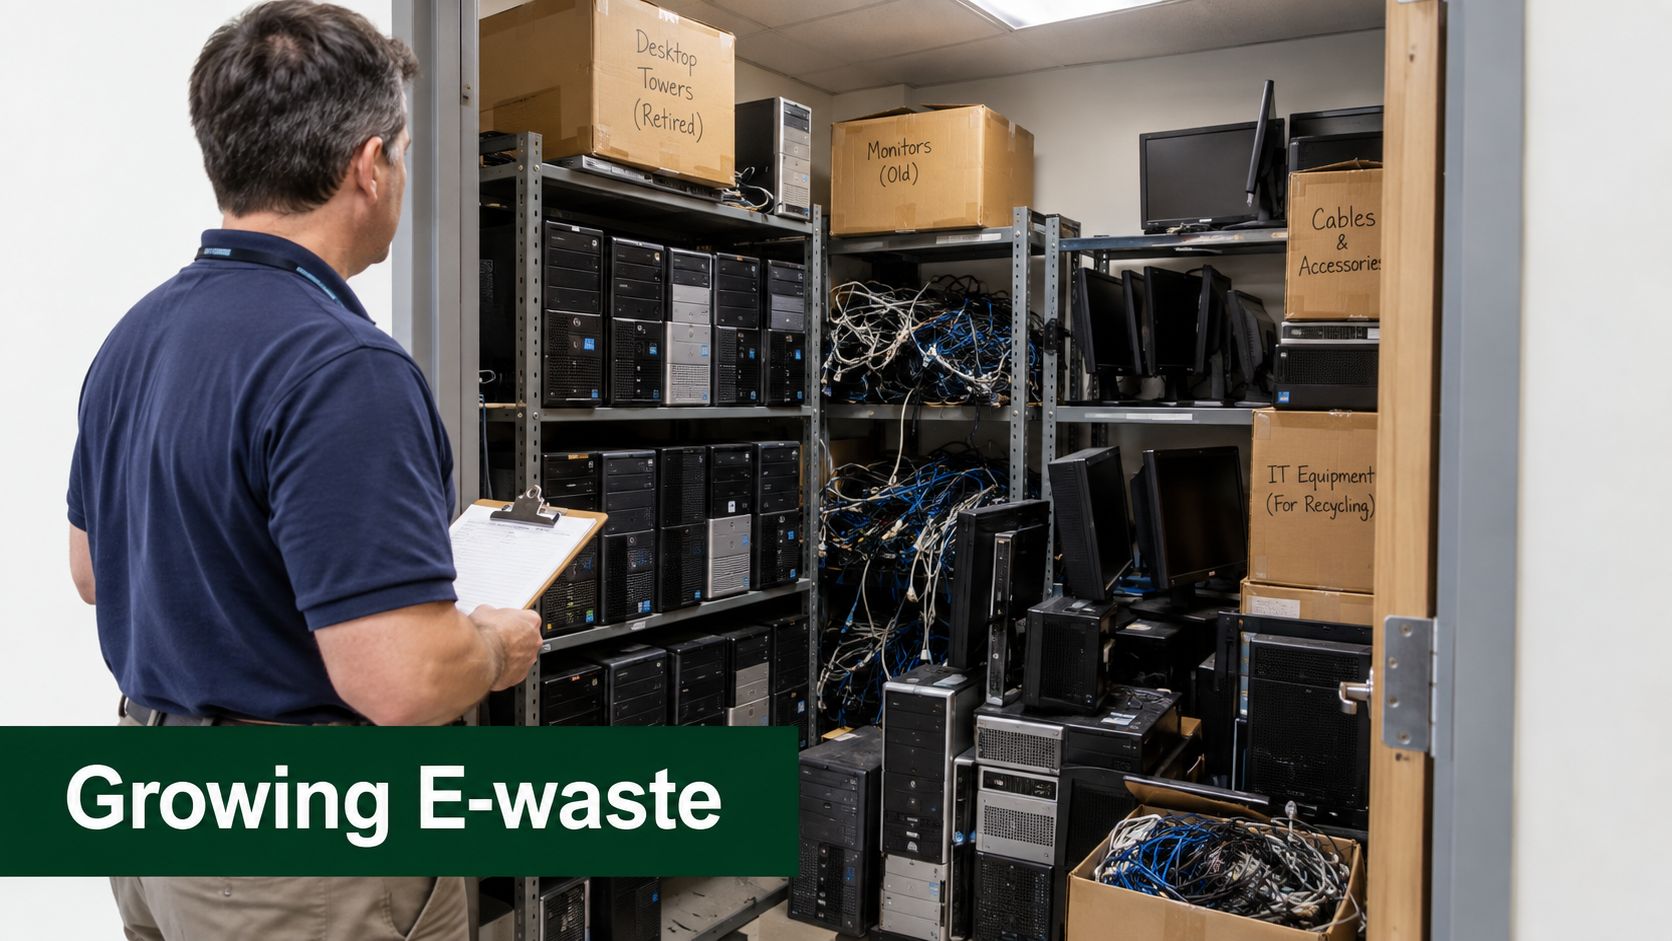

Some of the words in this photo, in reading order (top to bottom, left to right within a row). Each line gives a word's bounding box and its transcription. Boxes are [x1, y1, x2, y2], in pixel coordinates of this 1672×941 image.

[636, 29, 697, 76] Desktop
[637, 67, 694, 100] Towers
[633, 98, 704, 143] (Retired)
[867, 137, 932, 161] Monitors
[879, 161, 919, 188] (Old)
[1311, 205, 1376, 231] Cables
[1336, 233, 1349, 250] &
[1267, 464, 1290, 484] IT
[1297, 464, 1375, 492] Equipment
[1266, 492, 1298, 518] (For
[1304, 493, 1375, 522] Recycling)
